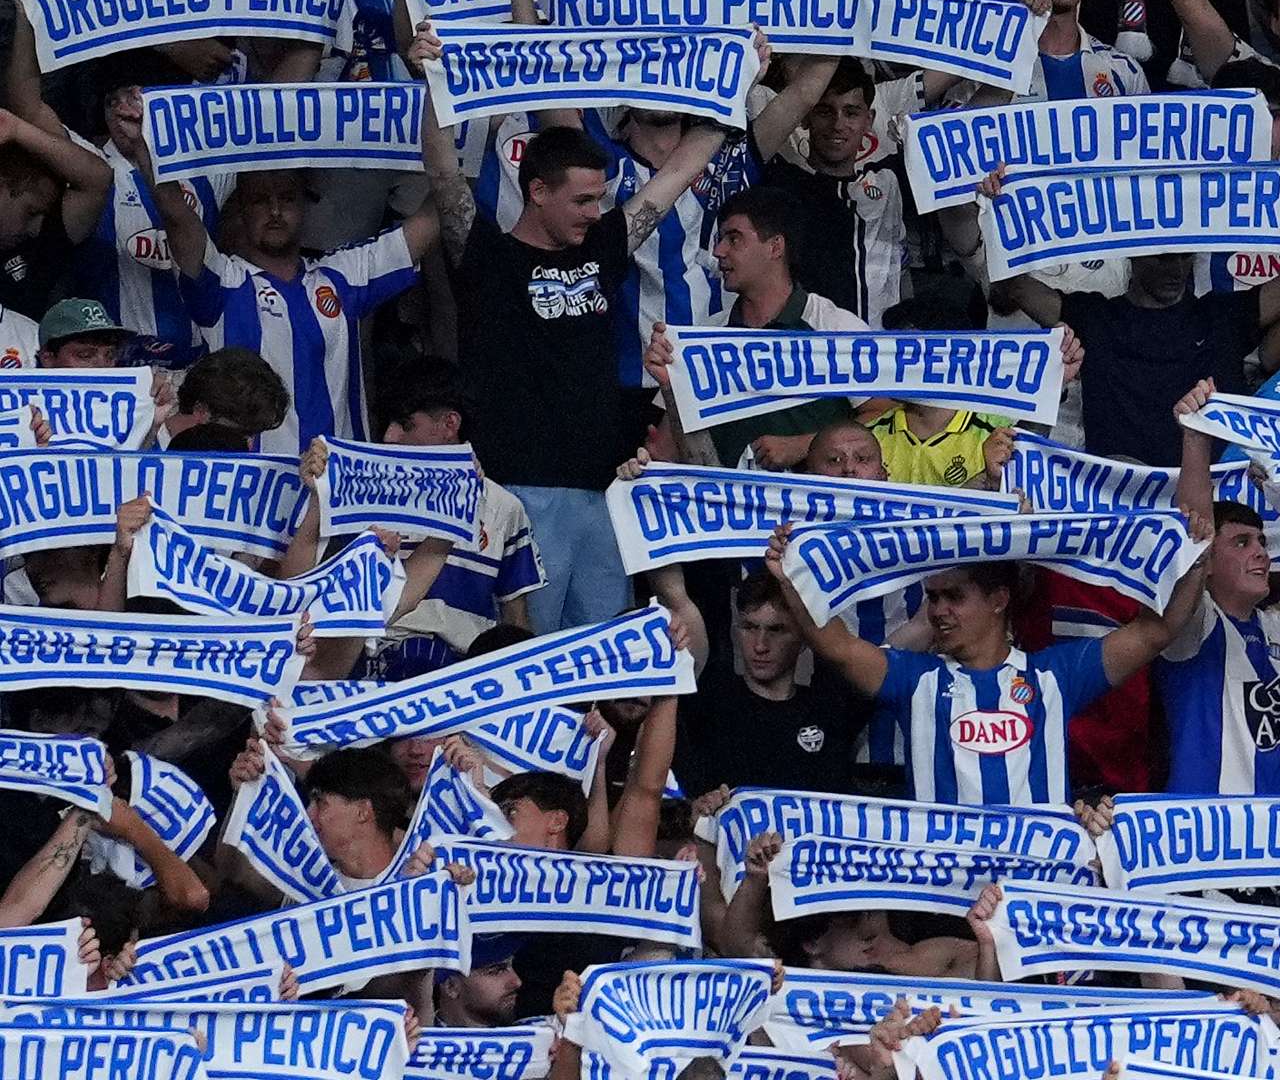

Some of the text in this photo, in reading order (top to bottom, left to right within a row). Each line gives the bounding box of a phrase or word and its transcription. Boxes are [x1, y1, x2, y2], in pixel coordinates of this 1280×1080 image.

[446, 35, 744, 99] ORGULLO PERICO
[152, 87, 321, 157] ORGULLO
[918, 102, 1254, 182] ORGULLO PERICO
[999, 174, 1181, 252] ORGULLO
[684, 340, 1048, 401] ORGULLO PERICO
[328, 456, 481, 520] ORGULLO PERICO
[799, 516, 1185, 590] ORGULLO PERICO
[518, 616, 680, 692] PERICO
[957, 719, 1018, 745] DANI
[318, 874, 460, 960] PERICO
[1008, 900, 1205, 953] ORGULLO
[233, 1007, 395, 1078] PERICO
